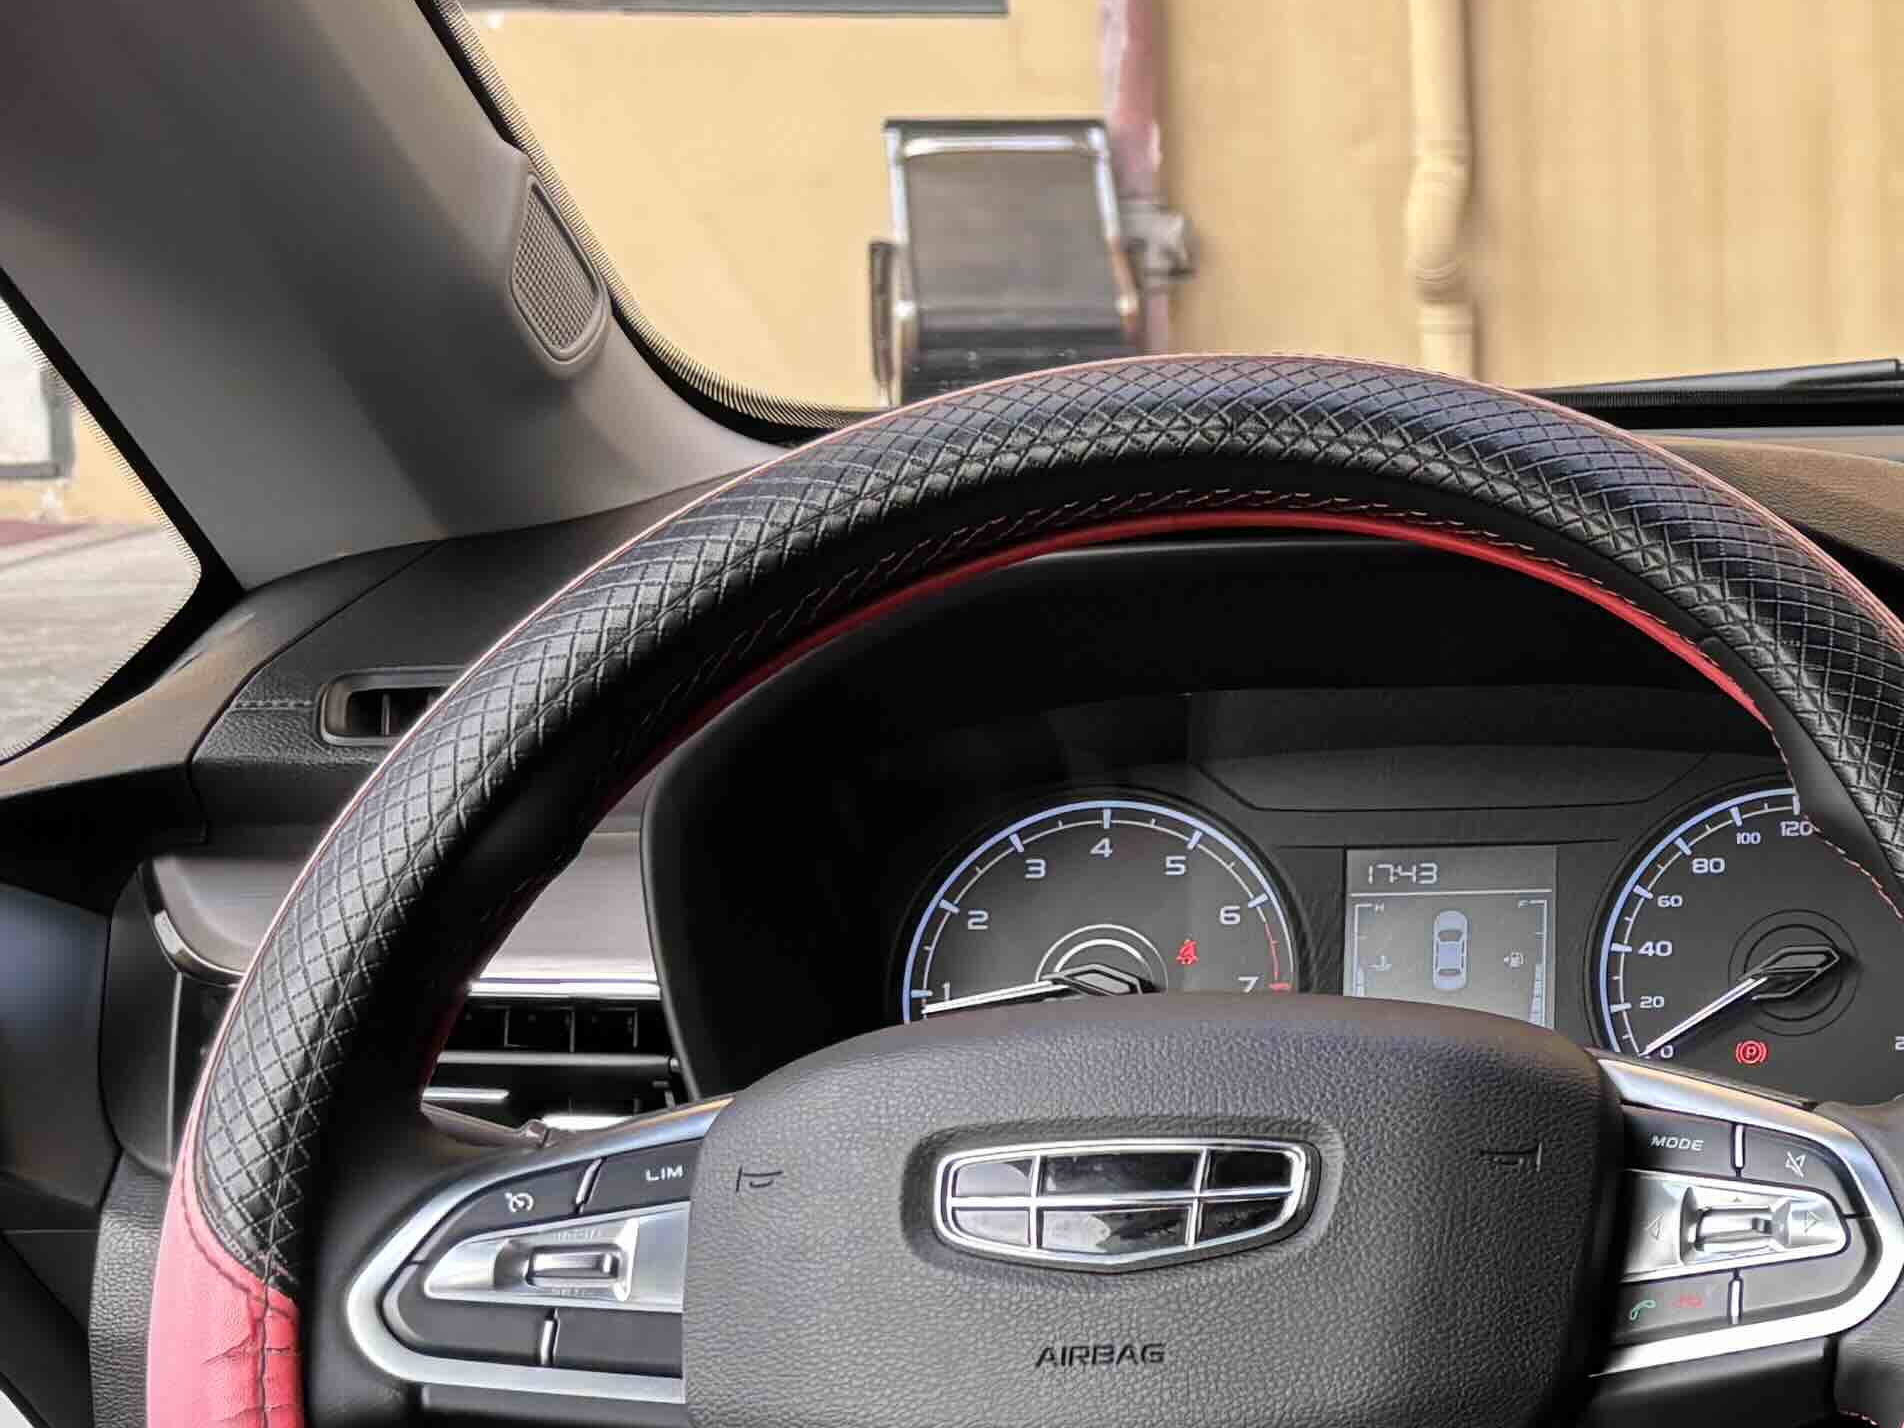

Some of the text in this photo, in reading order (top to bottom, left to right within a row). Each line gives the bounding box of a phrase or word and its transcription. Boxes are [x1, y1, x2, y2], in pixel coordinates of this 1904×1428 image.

[1780, 820, 1812, 837] 120
[1736, 832, 1761, 845] 100
[1090, 838, 1113, 858] 4
[1025, 859, 1046, 879] 3
[1165, 856, 1187, 876] 5
[1368, 862, 1438, 885] 17:43
[1692, 858, 1725, 874] 80
[1658, 895, 1683, 908] 60
[967, 910, 989, 930] 2
[1219, 906, 1241, 926] 6
[1638, 940, 1673, 956] 40
[1237, 975, 1259, 993] 7
[1640, 996, 1665, 1009] 20
[1649, 1135, 1704, 1152] MODE
[646, 1165, 684, 1183] LIM
[1034, 1342, 1168, 1369] AIRBAG
